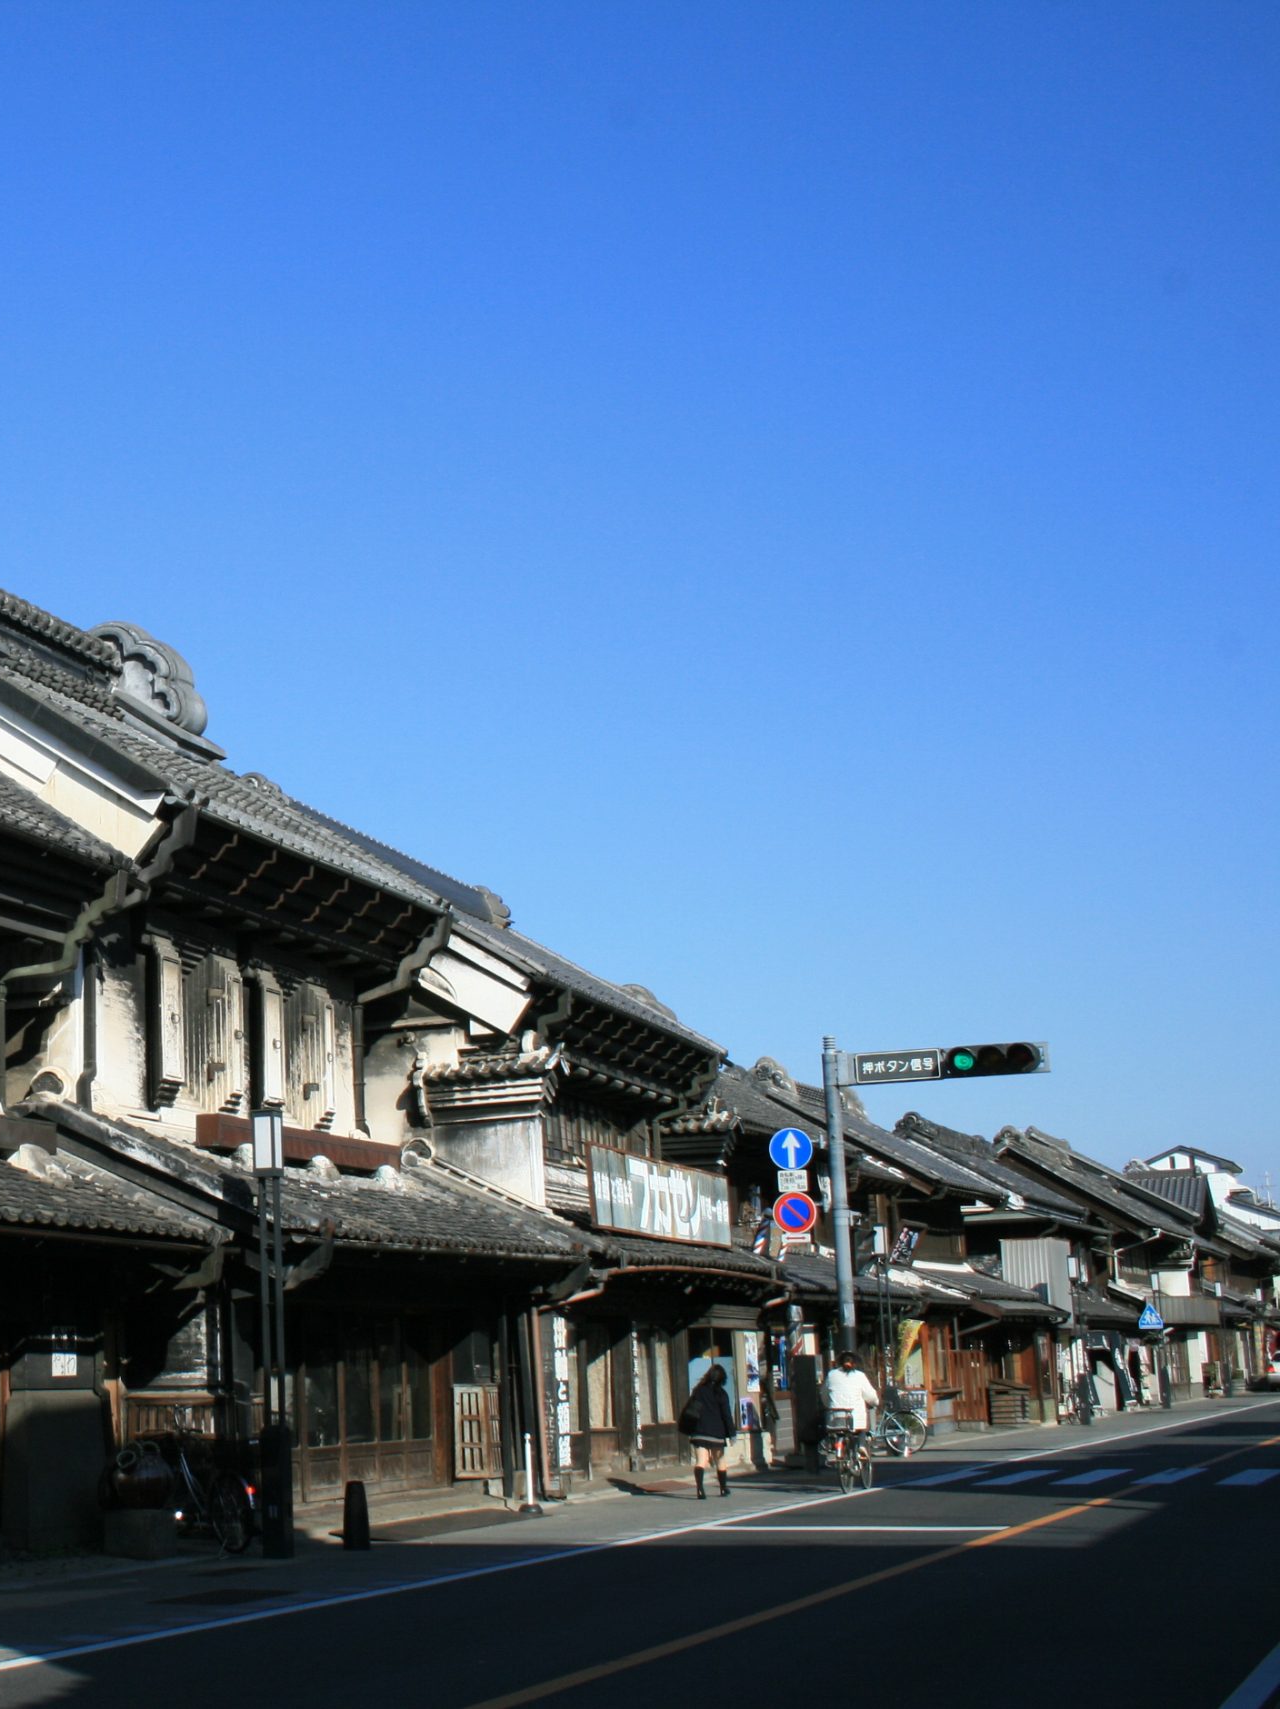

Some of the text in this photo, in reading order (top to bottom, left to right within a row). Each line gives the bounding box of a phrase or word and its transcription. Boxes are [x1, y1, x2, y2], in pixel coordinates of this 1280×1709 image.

[862, 1057, 934, 1075] 押ボタン信号
